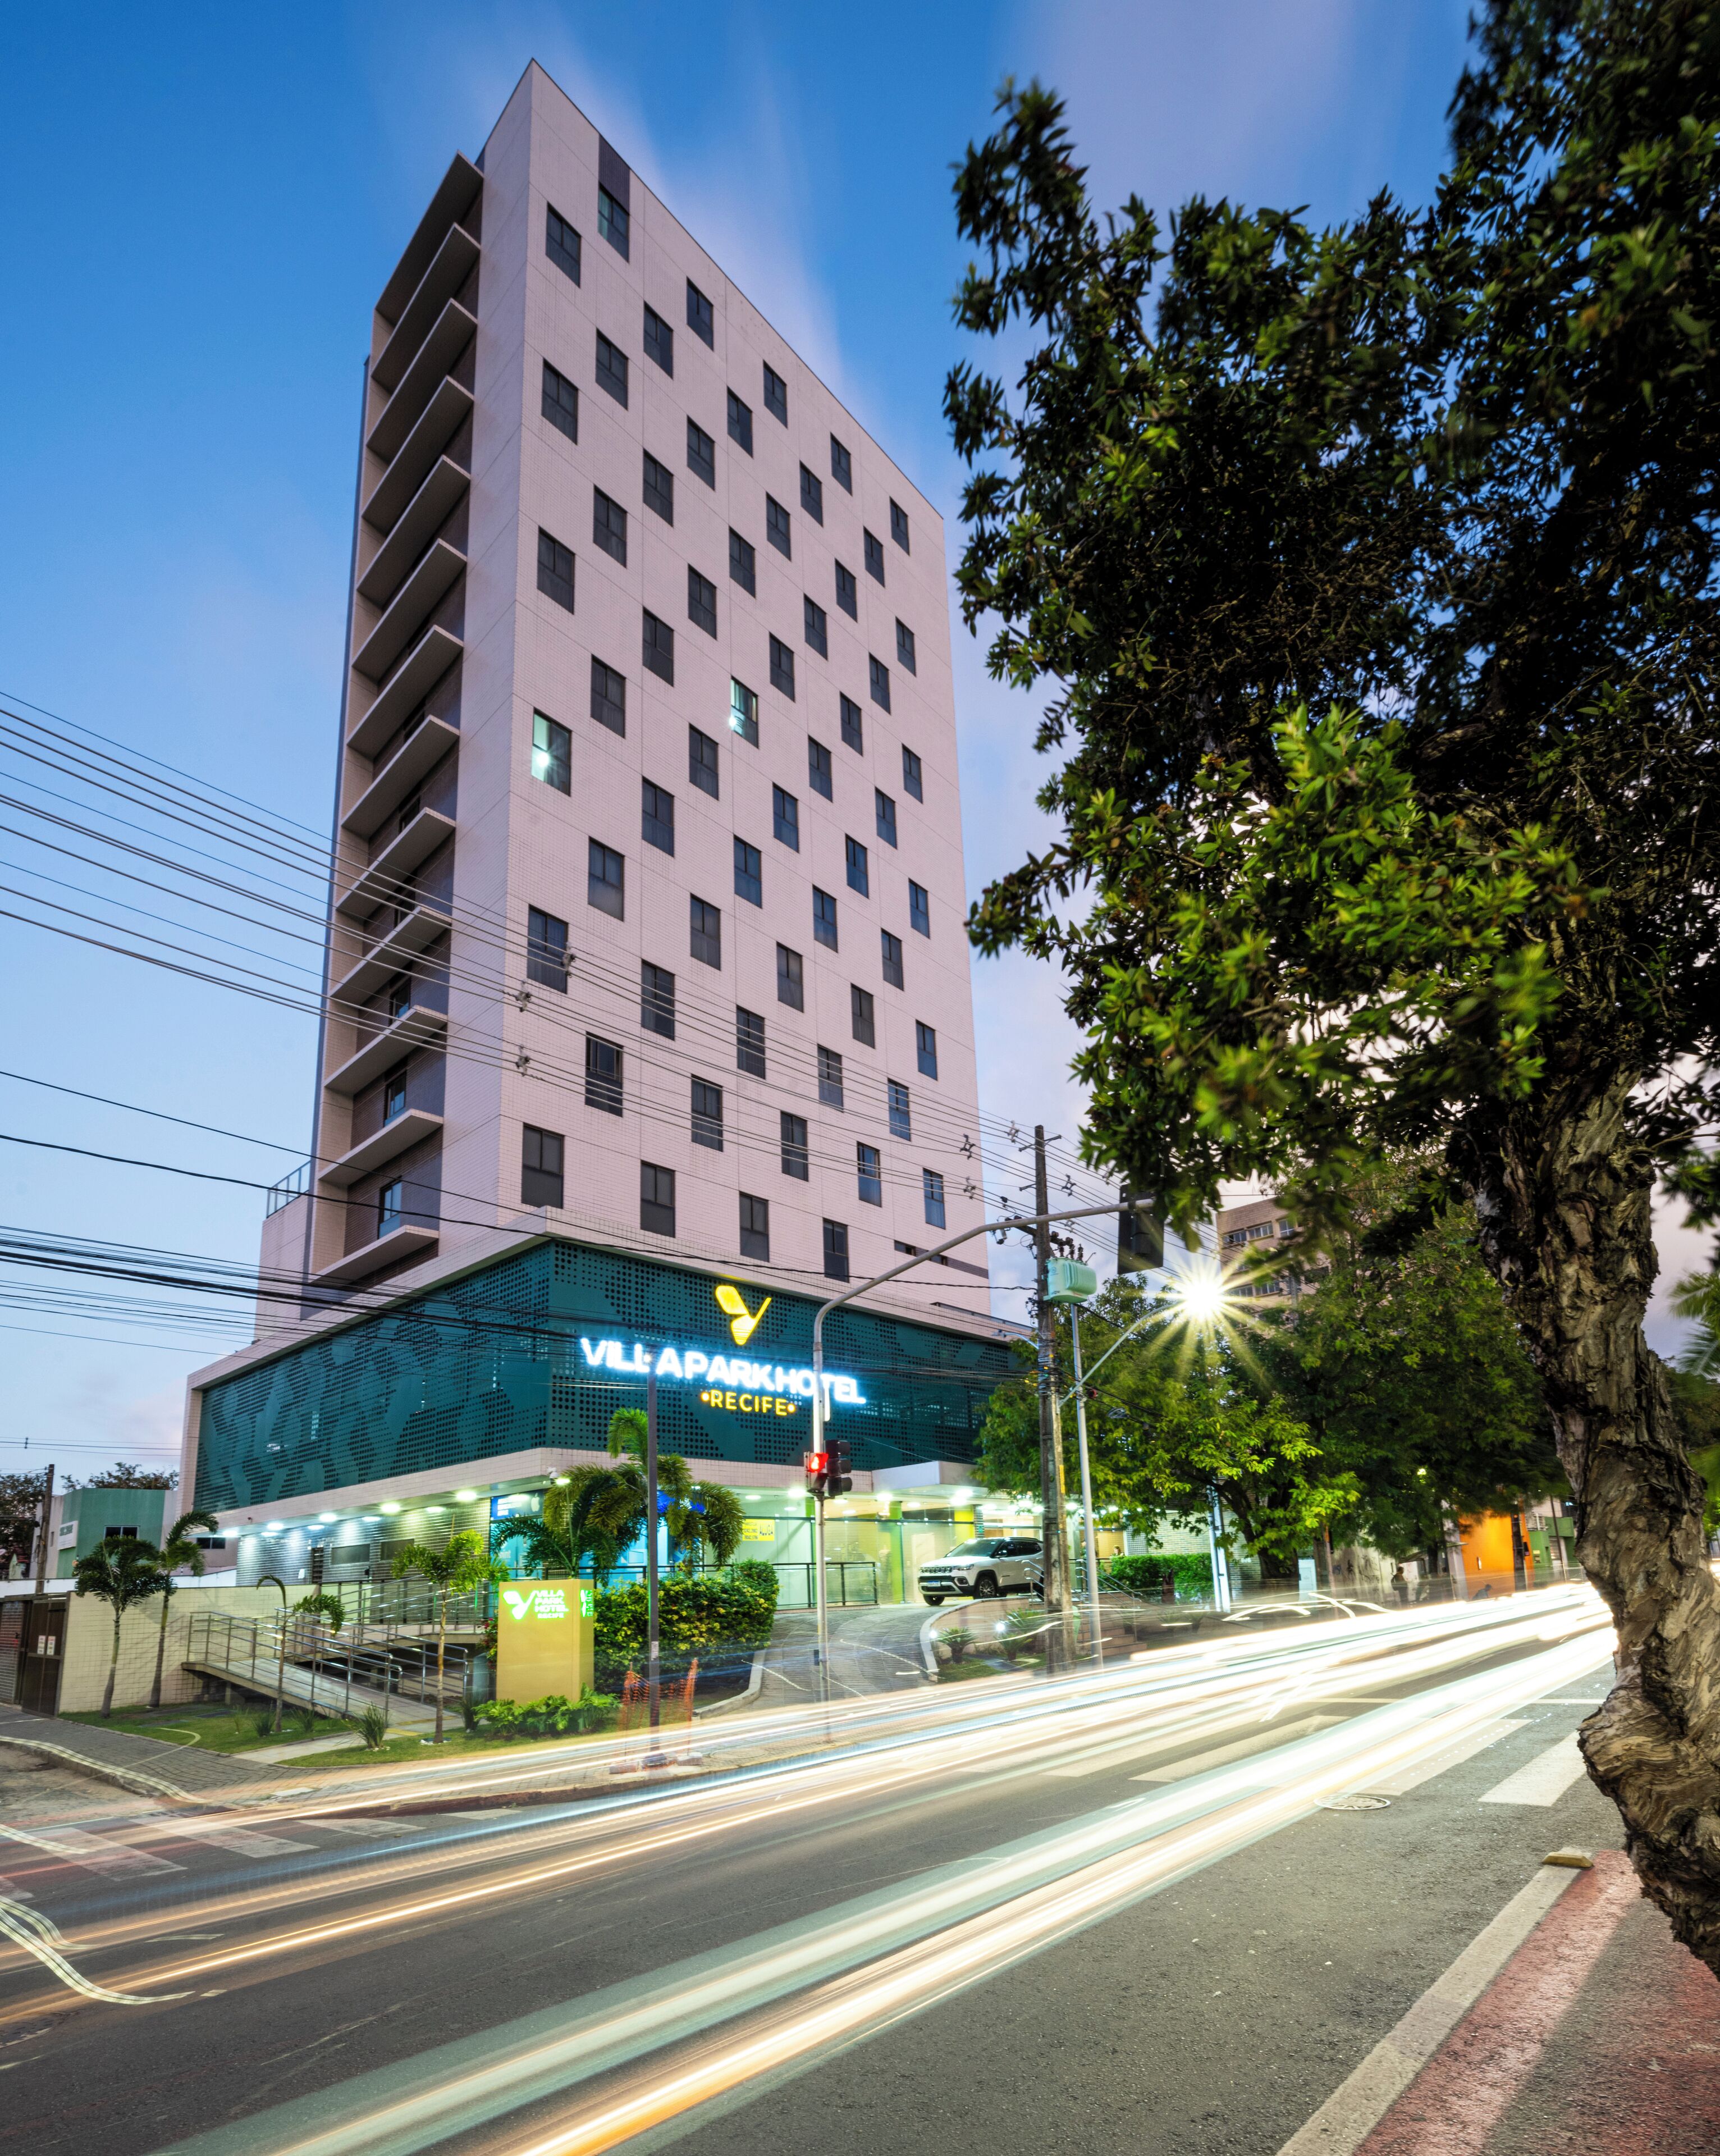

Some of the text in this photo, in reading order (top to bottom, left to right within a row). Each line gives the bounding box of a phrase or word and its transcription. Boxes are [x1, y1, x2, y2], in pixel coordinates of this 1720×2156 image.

[580, 1337, 867, 1404] VILLA PARK HOTEL
[710, 1389, 788, 1416] RECIFE
[535, 1604, 569, 1613] HOTEL
